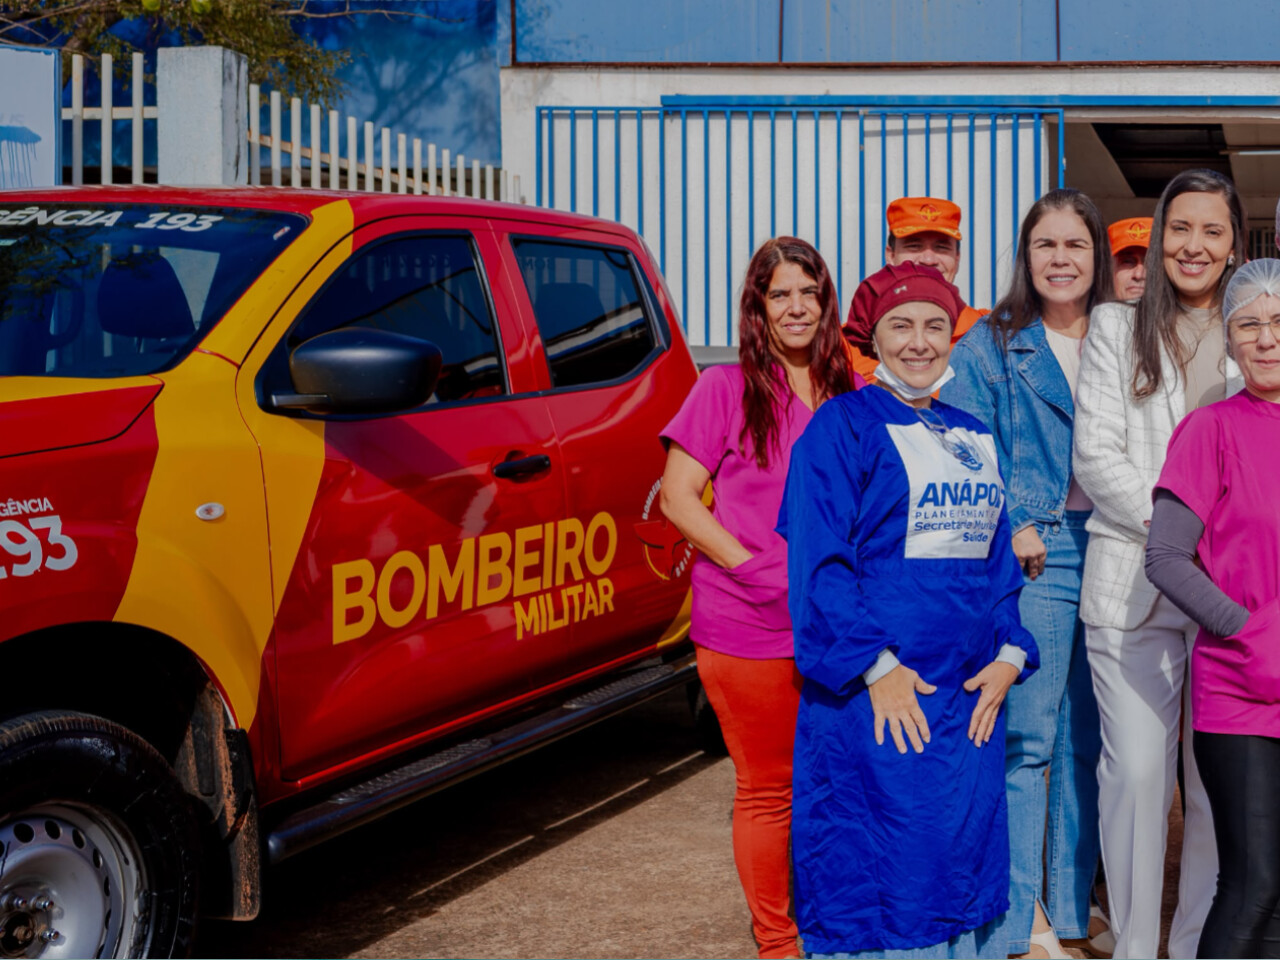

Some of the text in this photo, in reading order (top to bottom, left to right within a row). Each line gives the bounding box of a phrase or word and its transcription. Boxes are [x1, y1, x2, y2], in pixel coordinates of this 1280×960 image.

[134, 211, 225, 232] 193
[0, 515, 78, 579] 93
[332, 511, 617, 645] BOMBEIRO
[513, 577, 614, 641] MILITAR
